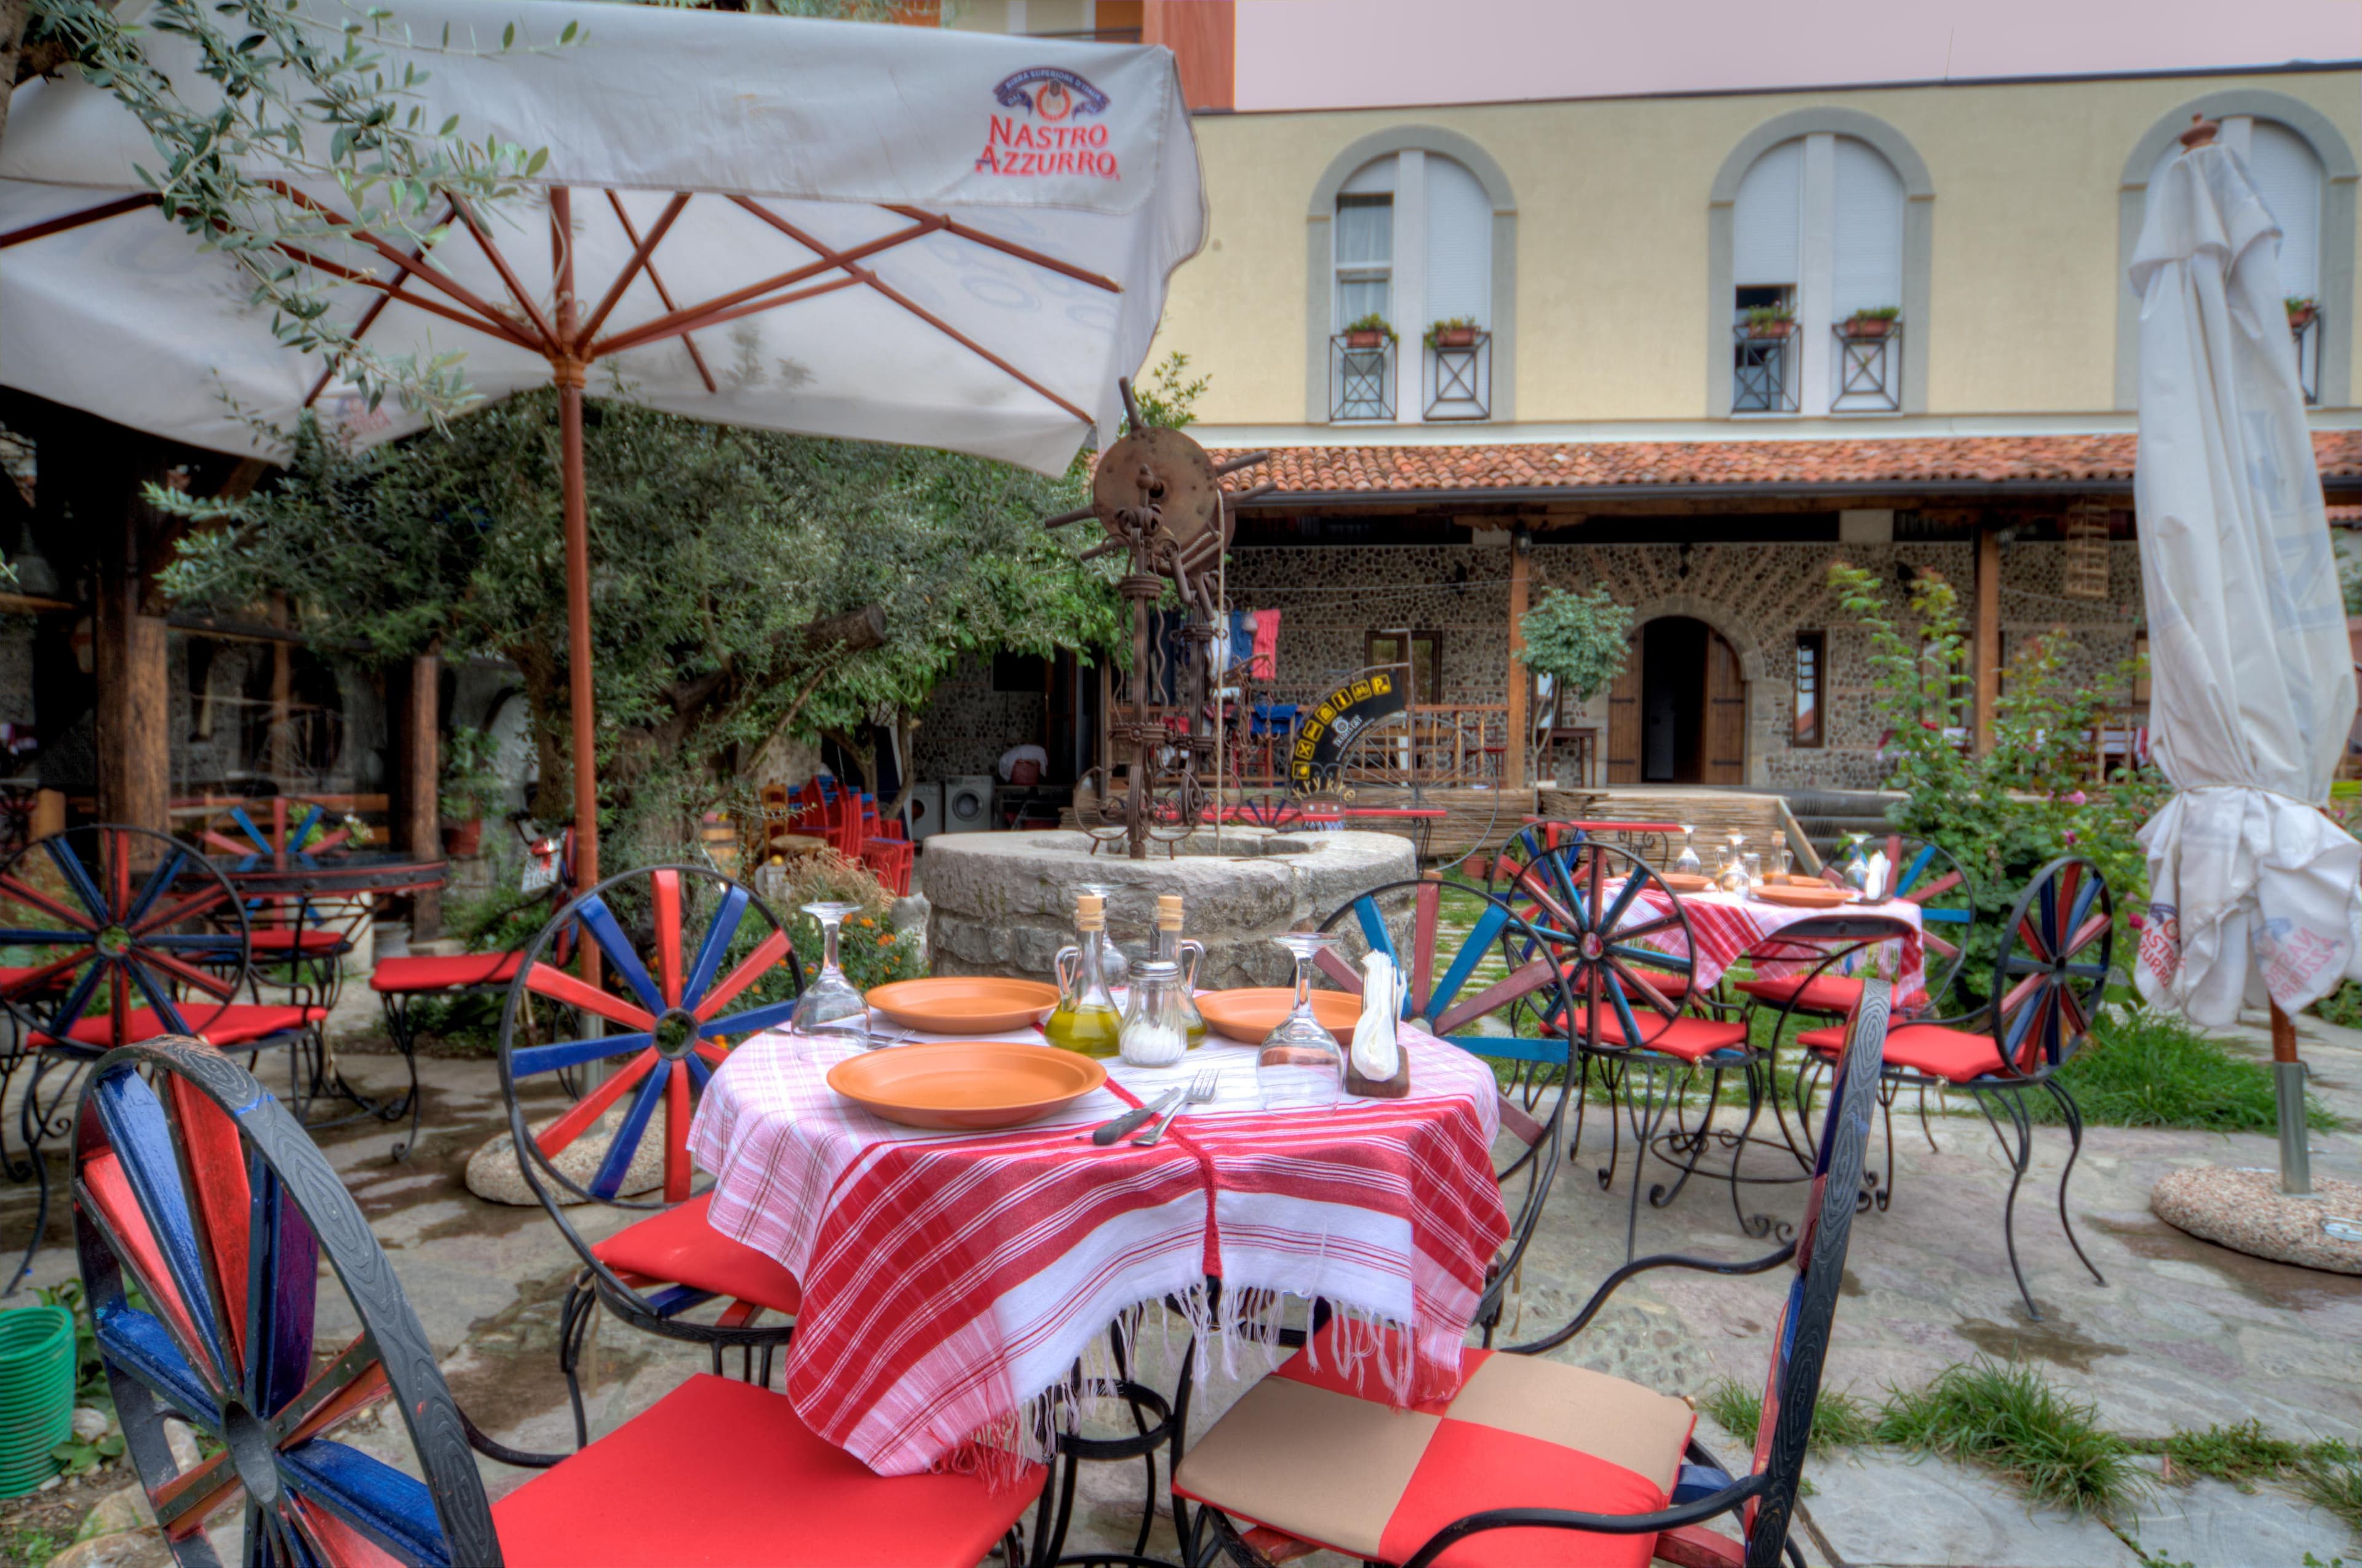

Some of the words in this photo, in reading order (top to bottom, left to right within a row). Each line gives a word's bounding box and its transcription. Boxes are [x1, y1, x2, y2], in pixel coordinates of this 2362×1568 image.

[1030, 70, 1073, 84] SUPERIORE
[989, 113, 1108, 149] NASTRO
[975, 145, 1118, 178] AZZURRO
[2142, 921, 2178, 971] ASTRO
